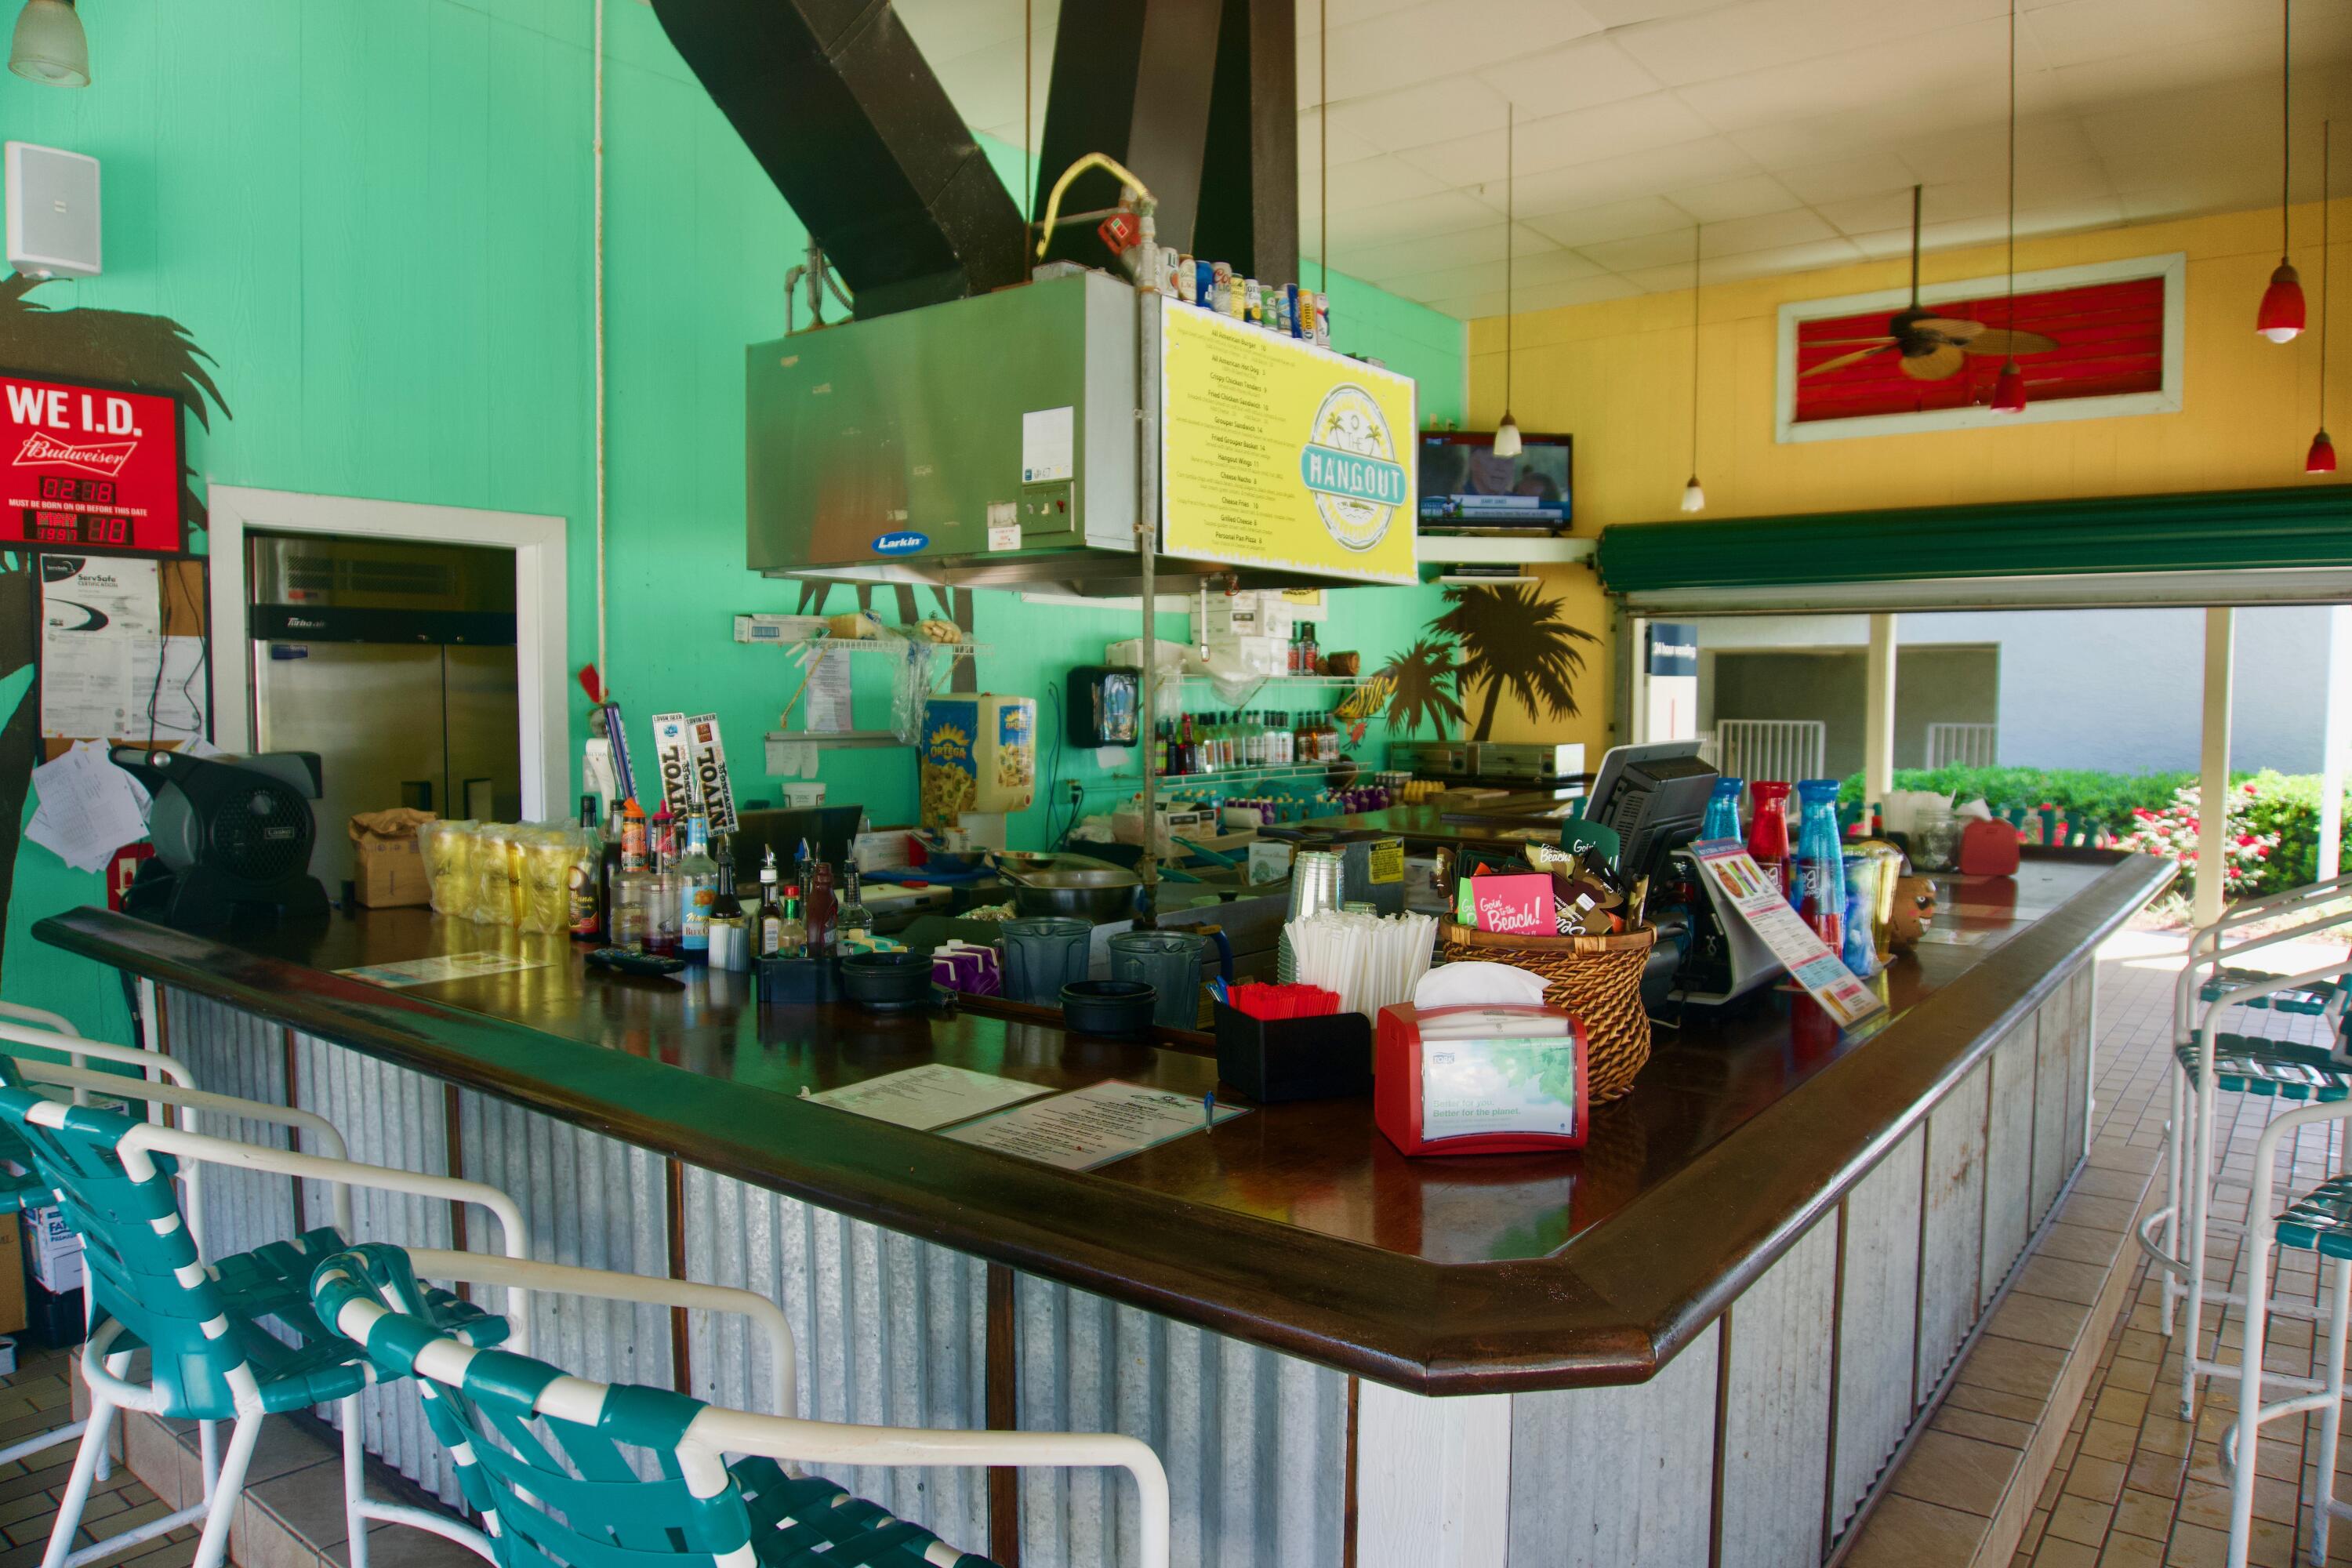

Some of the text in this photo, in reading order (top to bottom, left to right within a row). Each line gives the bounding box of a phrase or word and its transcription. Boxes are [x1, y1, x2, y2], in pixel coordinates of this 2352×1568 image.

[1304, 303, 1313, 339] Corona
[1218, 331, 1240, 343] American
[1241, 338, 1256, 350] Burger
[1218, 356, 1240, 368] American
[1250, 365, 1260, 376] Dog
[1210, 372, 1225, 383] Crispy
[1225, 376, 1243, 387] Chicken
[1244, 381, 1261, 393] Tenders
[1207, 389, 1220, 399] Fried
[1221, 392, 1239, 403] Chicken
[1240, 397, 1261, 409] Sandwich
[5, 384, 143, 437] WE I.D.
[1214, 416, 1233, 427] Grouper
[1234, 419, 1255, 432] Sandwich
[1211, 434, 1223, 442] Fried
[1224, 436, 1243, 448] Grouper
[1243, 440, 1258, 450] Basket
[1343, 432, 1363, 452] THE
[23, 437, 125, 466] Budweiser
[1218, 452, 1238, 463] Hangout
[1238, 457, 1253, 467] Wings
[1220, 471, 1236, 481] Cheese
[1310, 452, 1400, 499] HANGOUT
[9, 499, 30, 507] MUST
[31, 499, 41, 508] BE
[42, 501, 62, 510] BORN
[64, 502, 74, 510] ON
[87, 504, 113, 514] BEFORE
[114, 506, 130, 515] THIS
[131, 508, 147, 517] DATE
[1221, 496, 1238, 506] Cheese
[1238, 499, 1250, 508] Fries
[1221, 514, 1236, 523] Grilled
[1236, 517, 1253, 525] Cheese
[878, 537, 923, 549] Larkin
[1215, 531, 1236, 541] Personal
[78, 574, 116, 583] ServSafe
[287, 617, 312, 627] Turbo
[1662, 641, 1675, 656] hour
[702, 713, 717, 722] BEER
[931, 746, 967, 760] ORTEGA
[1540, 848, 1572, 862] Beach!
[1480, 894, 1503, 911] Goin'
[1505, 906, 1515, 914] the
[1487, 896, 1541, 932] Beach!
[1433, 1054, 1455, 1065] TORK
[1433, 1099, 1495, 1109] Better for you.
[1433, 1107, 1521, 1118] Better for the planet.
